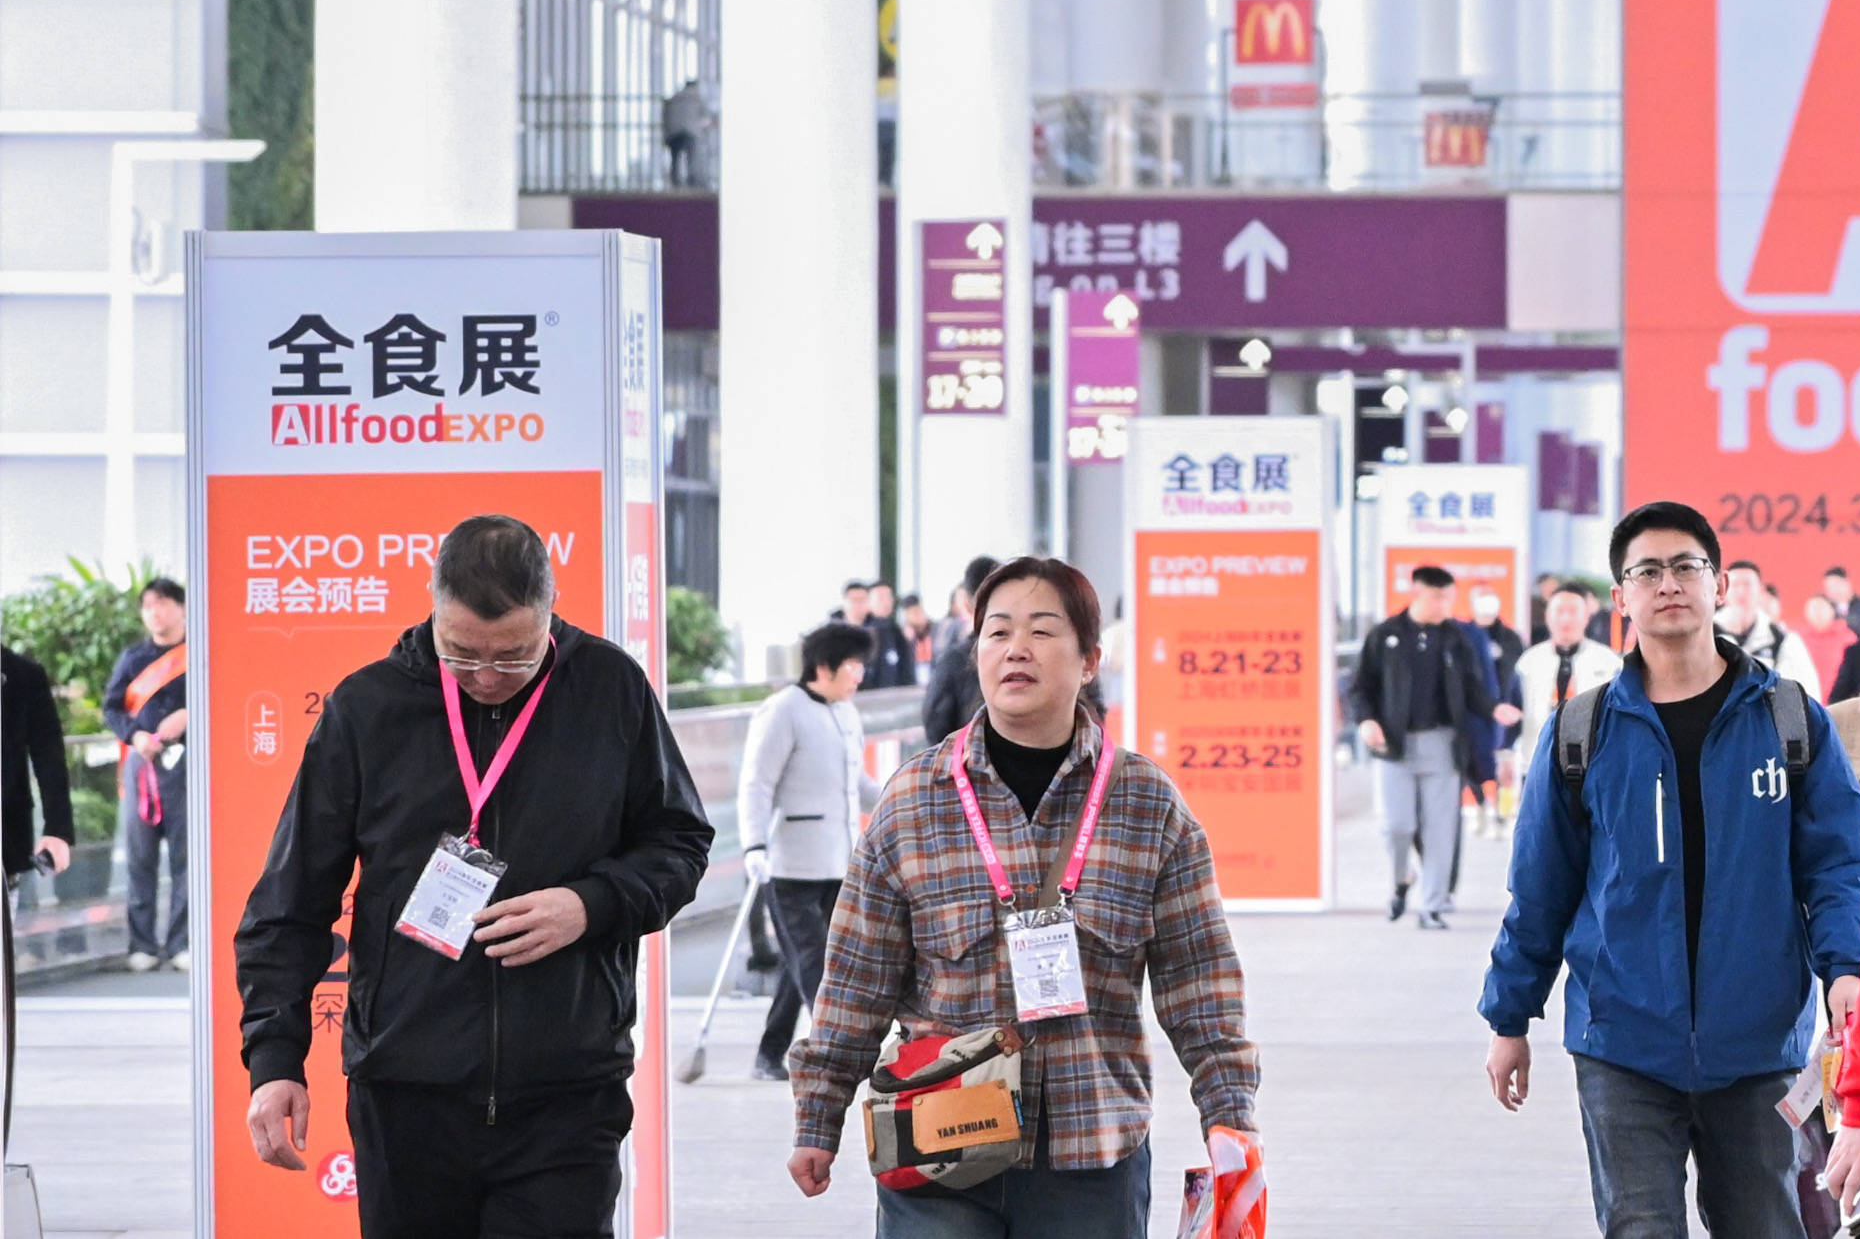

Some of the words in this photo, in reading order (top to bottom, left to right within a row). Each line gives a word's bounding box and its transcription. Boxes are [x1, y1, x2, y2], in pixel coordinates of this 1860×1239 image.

[268, 313, 541, 399] 全食展
[271, 403, 545, 446] AllfoodEXPO
[1162, 452, 1291, 492] 全食展
[1407, 490, 1496, 519] 全食展
[246, 534, 364, 570] EXPO
[1150, 555, 1208, 574] EXPO
[1212, 555, 1308, 575] PREVIEW
[245, 575, 389, 614] 展会预告
[1178, 649, 1303, 675] 8.21-23
[252, 704, 277, 756] 上海
[1179, 744, 1303, 769] 2.23-25
